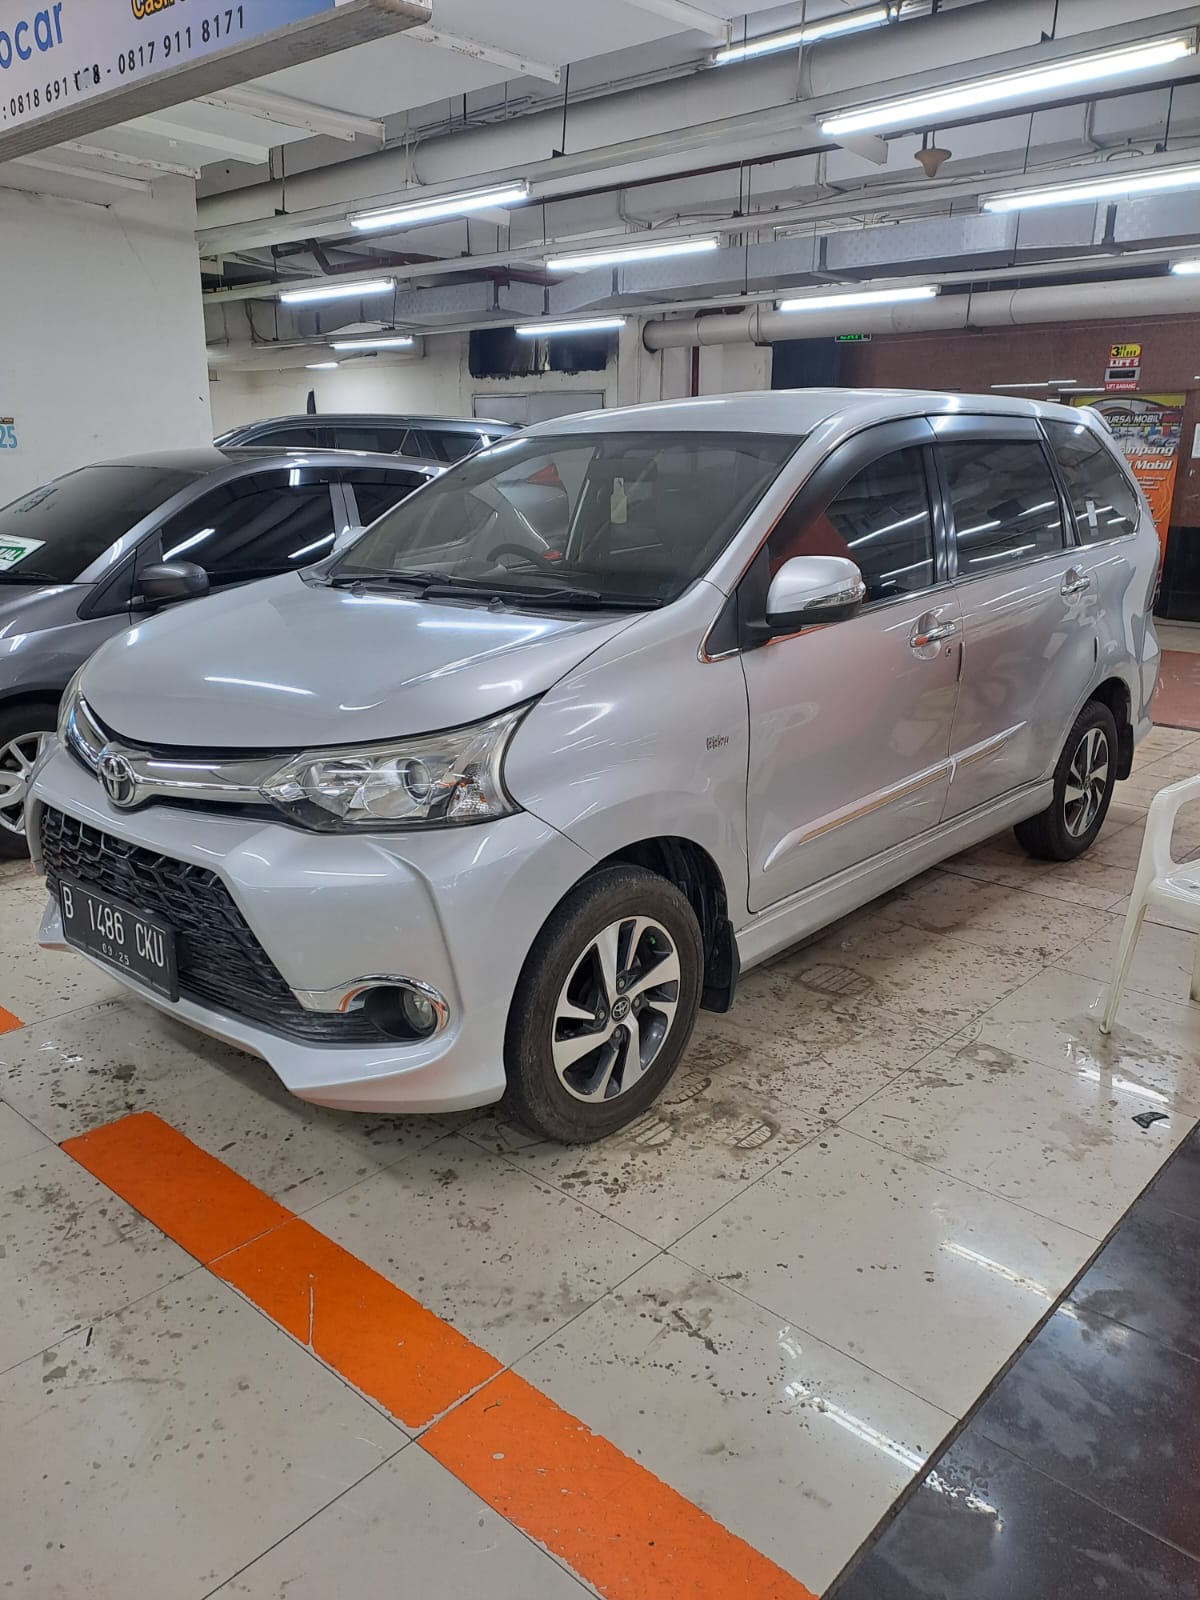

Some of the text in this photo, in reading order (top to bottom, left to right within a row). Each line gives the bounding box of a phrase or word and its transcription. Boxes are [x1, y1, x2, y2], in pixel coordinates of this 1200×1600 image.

[46, 76, 68, 103] 691
[118, 40, 155, 74] 0817
[163, 26, 191, 58] 911
[202, 5, 243, 43] 8171
[1134, 414, 1161, 423] MOBIL
[1135, 460, 1172, 470] Mobil
[63, 886, 164, 968] B 1486 CKU
